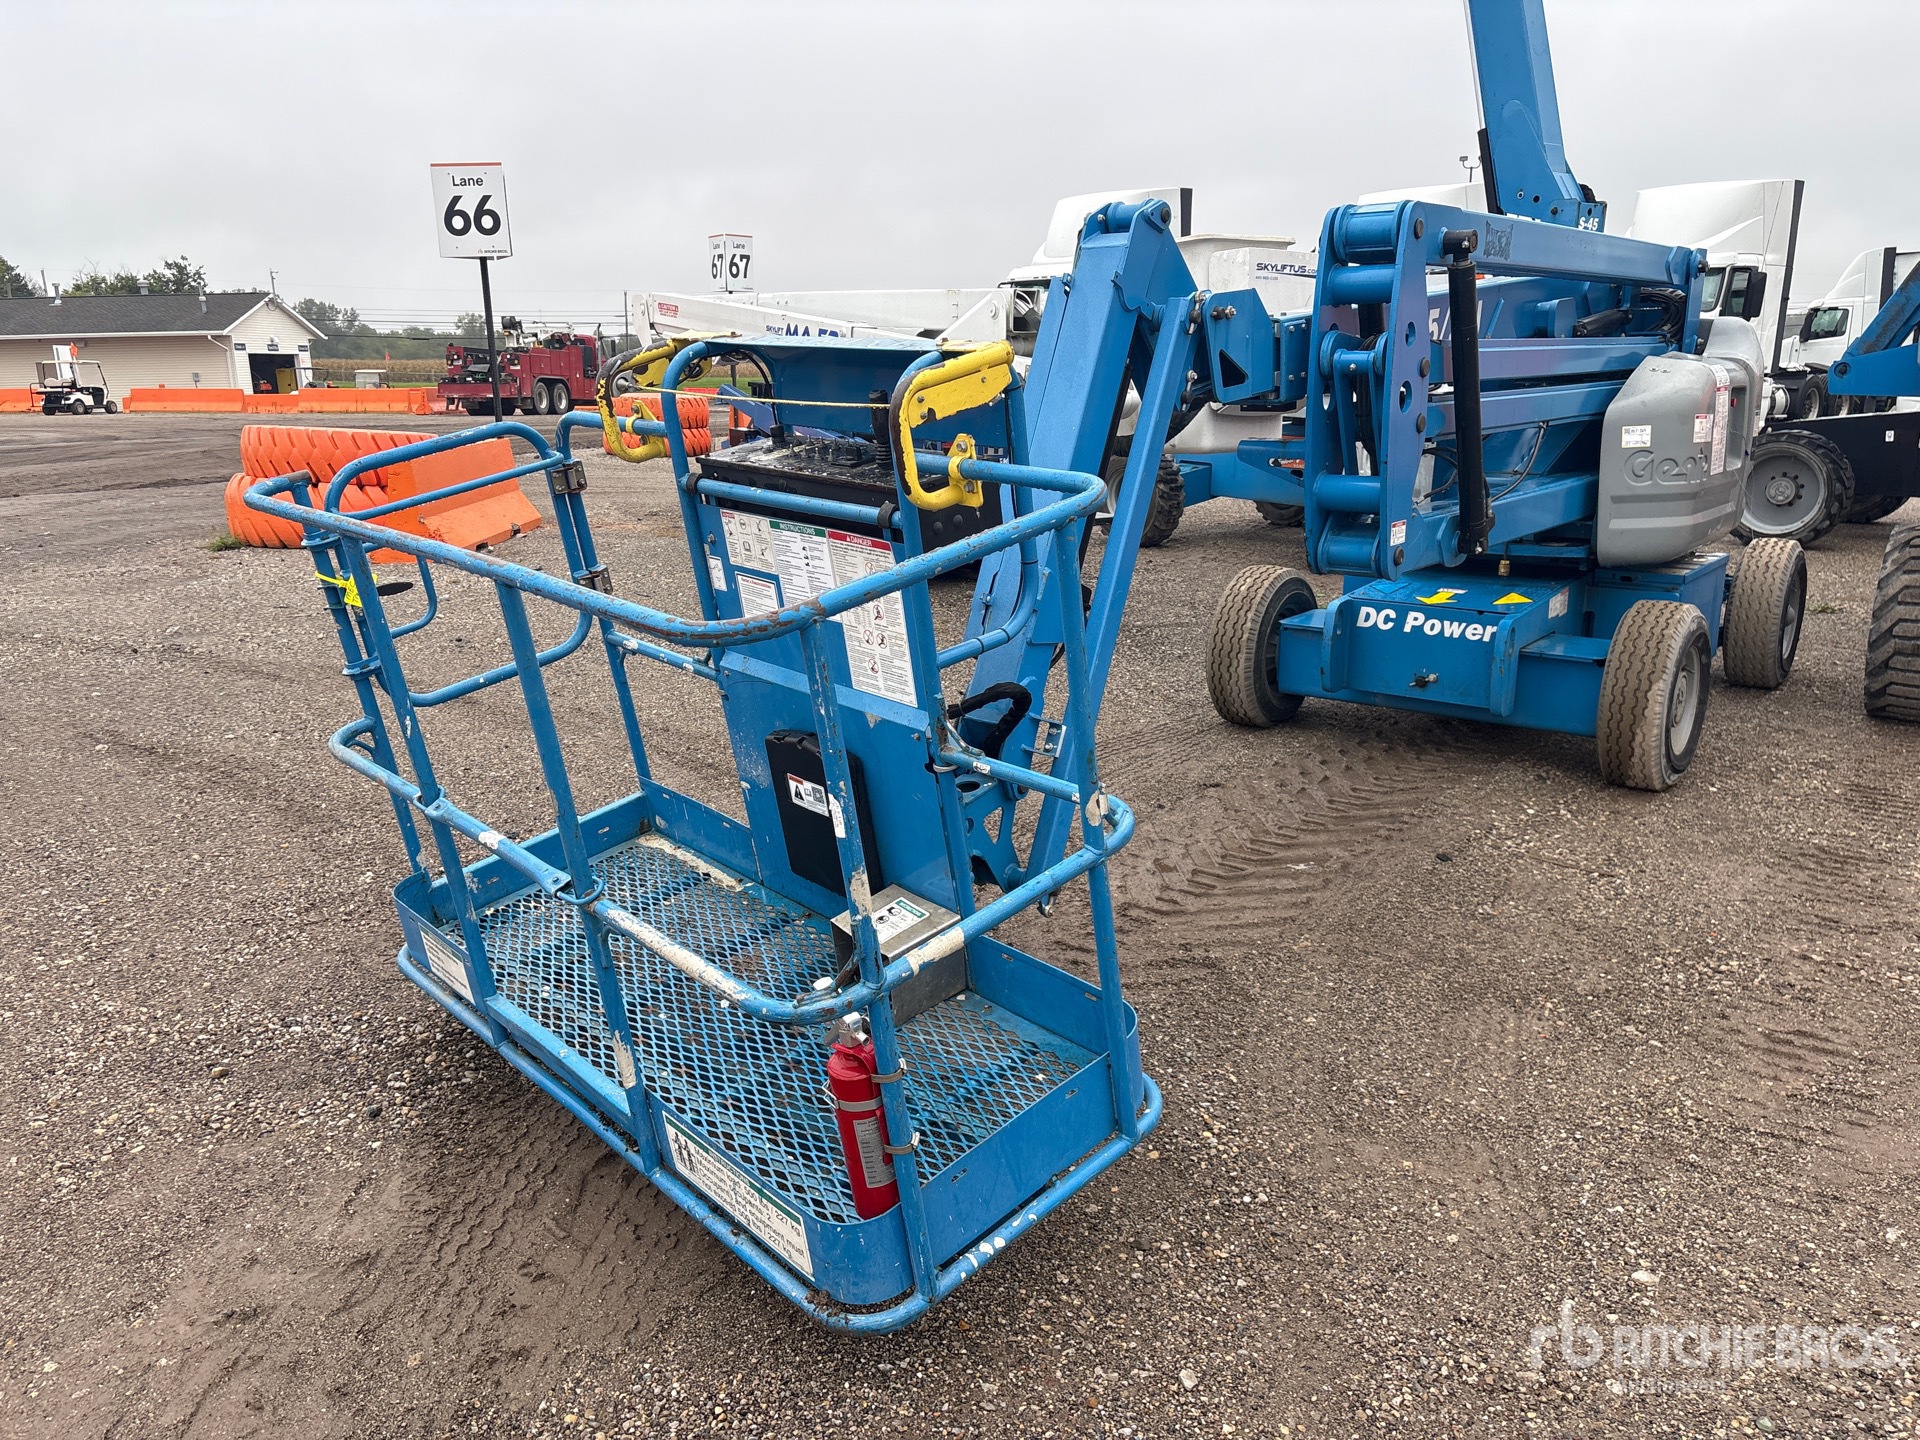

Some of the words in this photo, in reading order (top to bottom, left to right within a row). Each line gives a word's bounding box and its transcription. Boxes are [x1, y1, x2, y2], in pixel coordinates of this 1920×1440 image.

[452, 175, 484, 187] Lane
[444, 194, 501, 237] 66
[1578, 216, 1599, 231] S-45
[712, 254, 723, 279] 67
[729, 254, 750, 279] 67
[766, 324, 783, 333] SKYLIFT
[780, 523, 815, 535] INSTRUCTIONS
[850, 537, 872, 547] DANGER
[1356, 606, 1396, 630] DC
[1403, 611, 1497, 642] Power
[694, 1146, 724, 1176] Maximum
[743, 1184, 757, 1202] 500
[774, 1208, 789, 1227] 227
[696, 1157, 727, 1187] Maximum
[765, 1211, 773, 1224] 2.
[748, 1206, 785, 1244] equipment
[785, 1237, 805, 1259] must
[751, 1218, 762, 1233] lbs
[767, 1231, 781, 1249] 227
